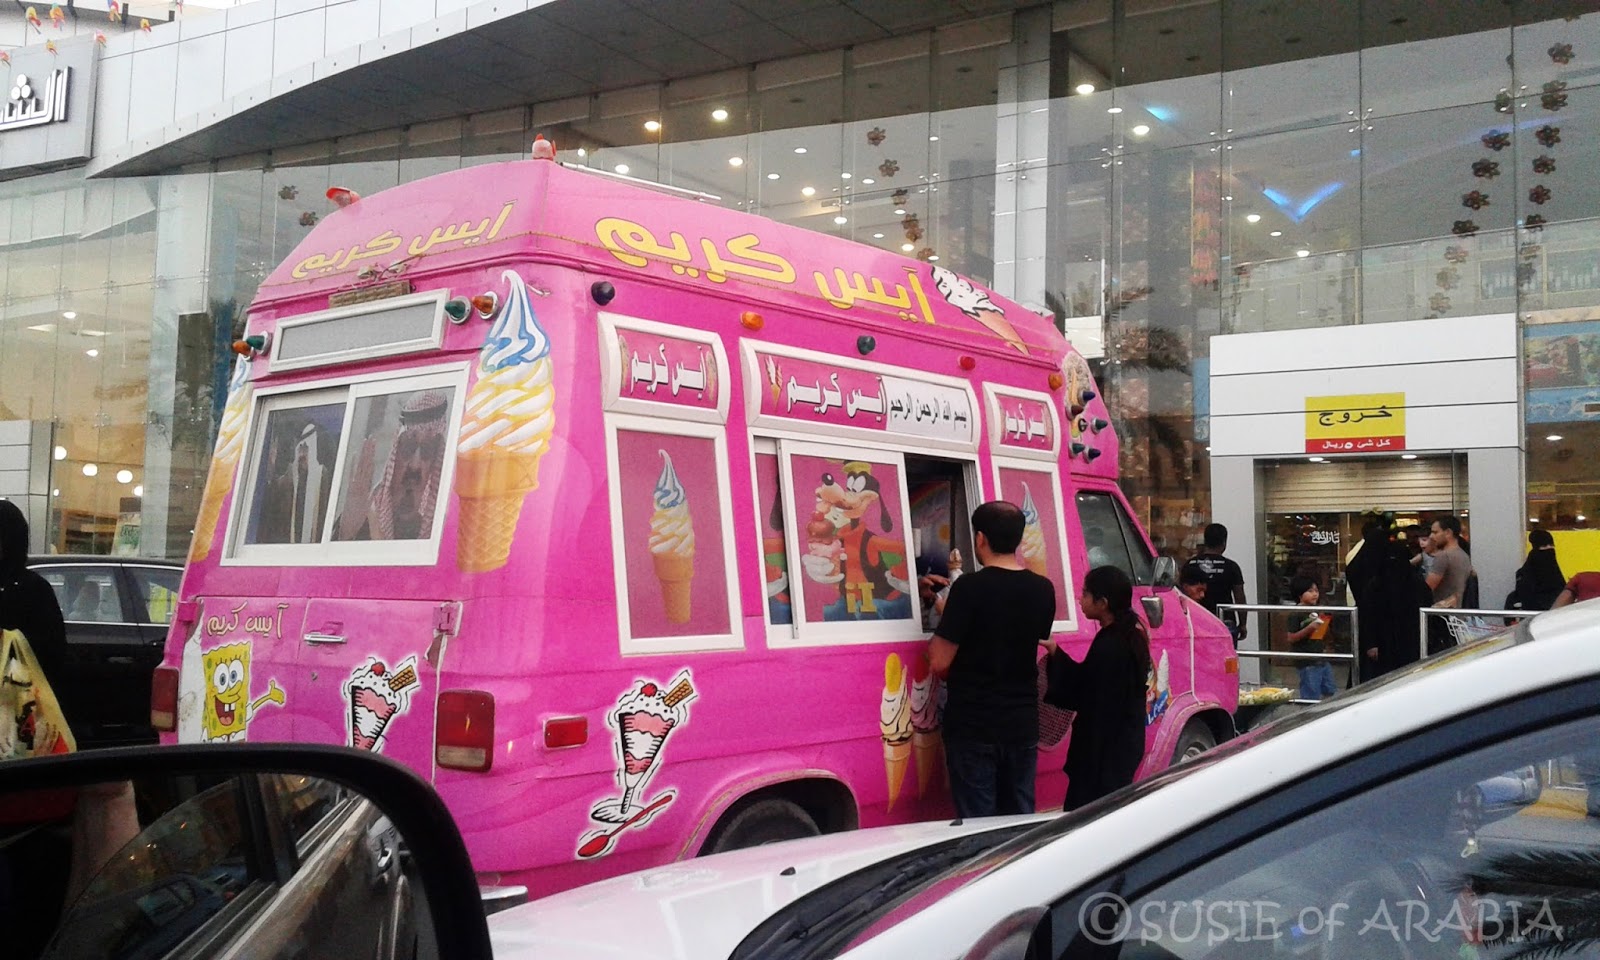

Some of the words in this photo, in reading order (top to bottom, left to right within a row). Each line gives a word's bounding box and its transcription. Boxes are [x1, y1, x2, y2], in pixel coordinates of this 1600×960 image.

[291, 230, 403, 279] كريم
[595, 217, 797, 284] كريم
[630, 342, 669, 395] كريم
[787, 372, 843, 414] كريم
[890, 392, 913, 422] الرحيم
[915, 397, 941, 424] الرحمن
[942, 398, 952, 421] الله
[953, 411, 967, 431] بسم
[1005, 403, 1027, 441] كريم
[1318, 405, 1393, 426] خروج
[1322, 440, 1344, 450] ريال
[1375, 438, 1391, 448] كل
[207, 601, 248, 636] كريم
